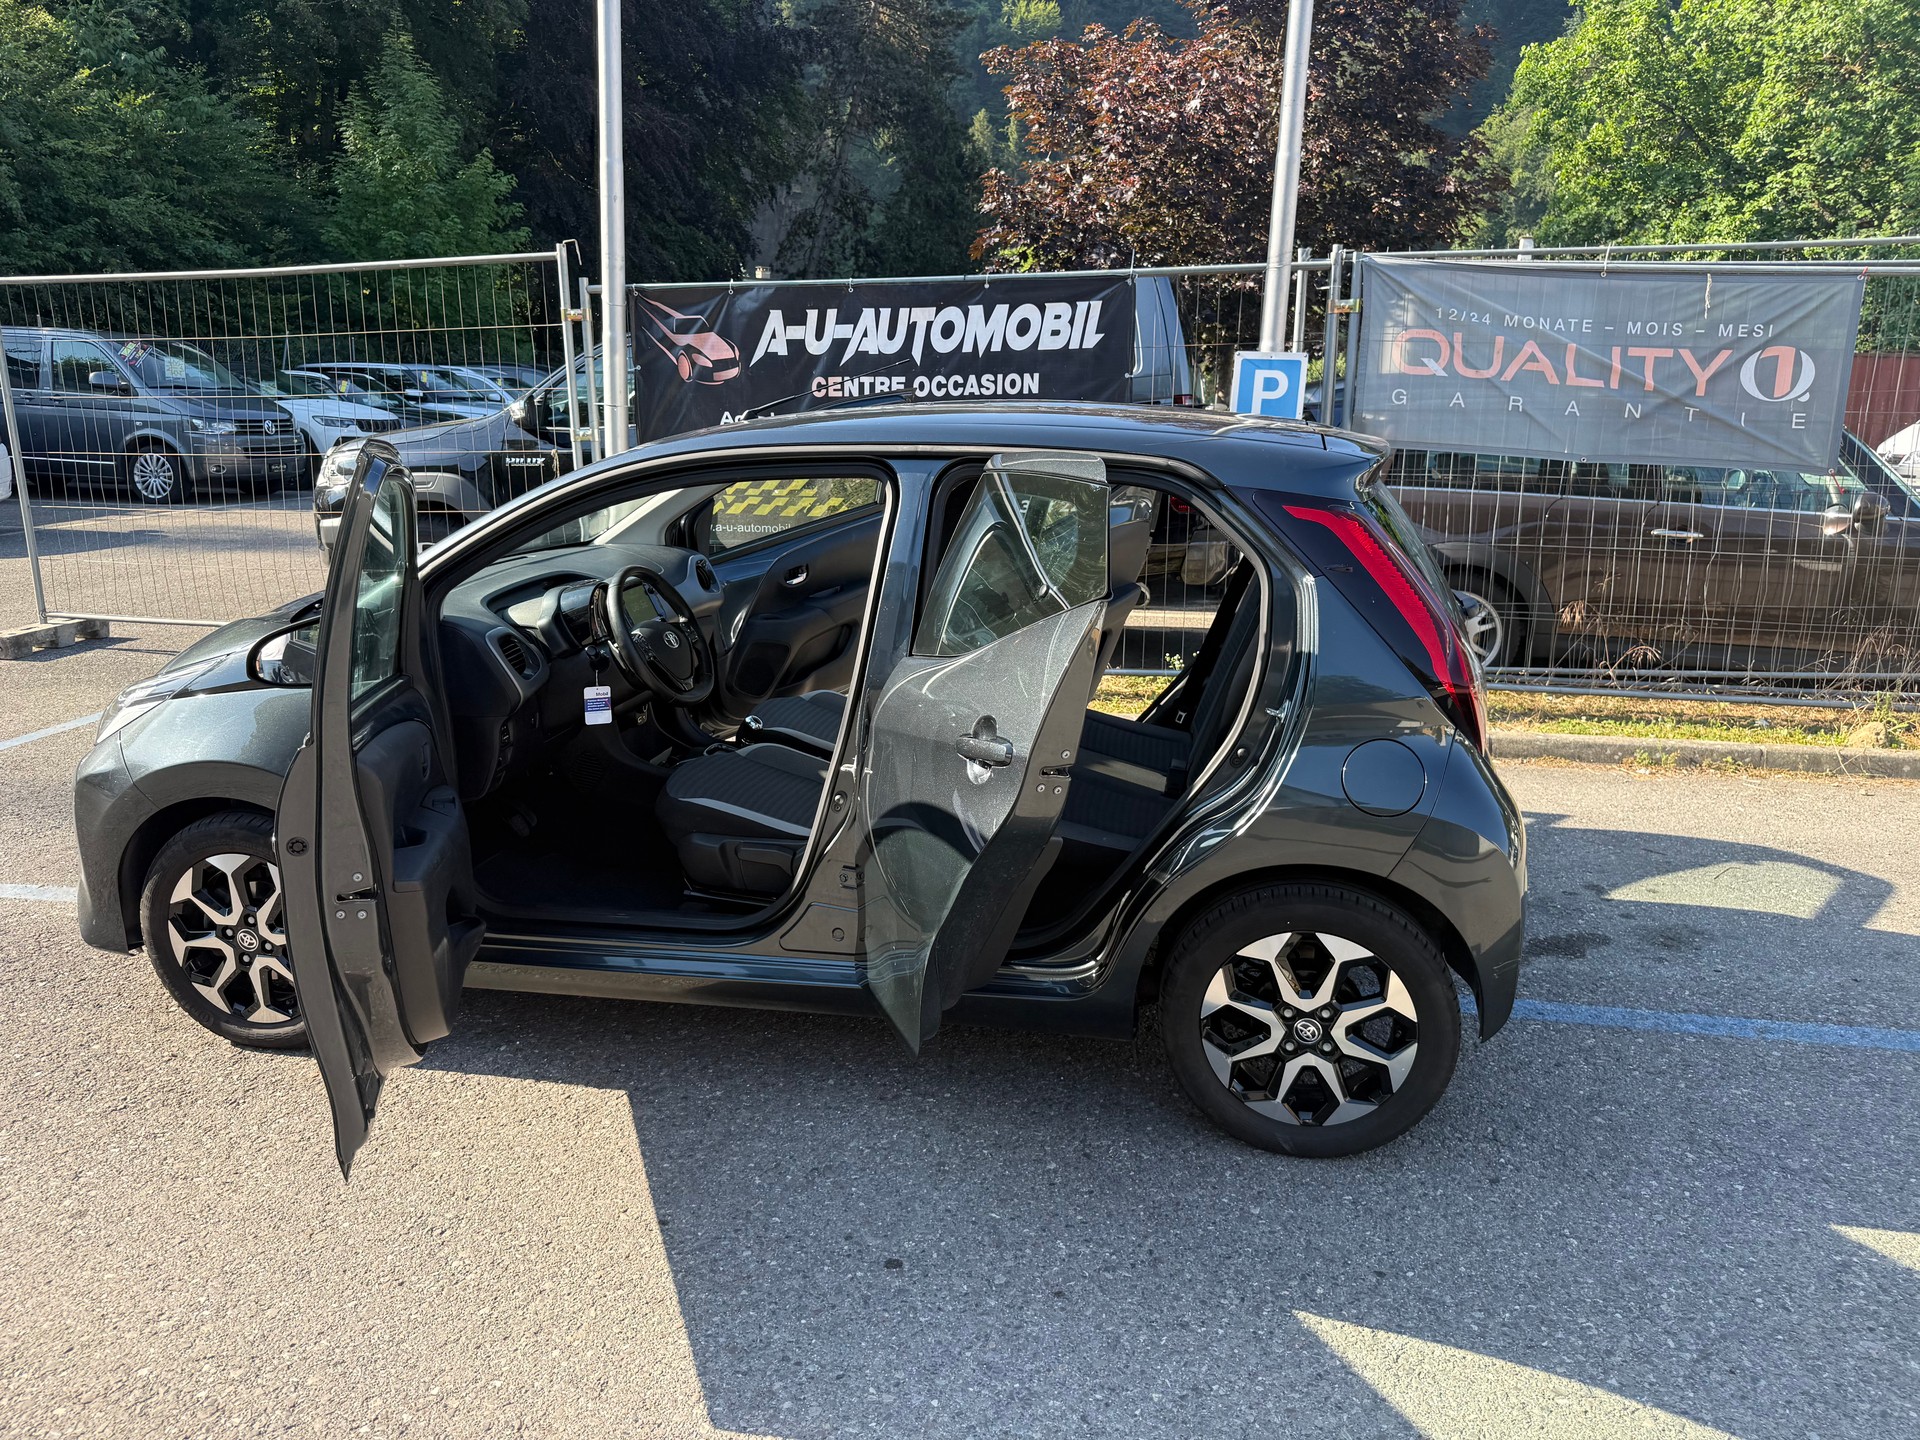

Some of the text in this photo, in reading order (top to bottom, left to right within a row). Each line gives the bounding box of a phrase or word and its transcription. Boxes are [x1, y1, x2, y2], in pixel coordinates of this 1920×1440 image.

[748, 300, 1105, 367] A-U-AUTOMOBIL
[1435, 307, 1491, 325] 12/24
[1503, 314, 1593, 333] MONATE
[1626, 321, 1683, 336] MOIS
[1718, 323, 1774, 338] MESI
[1393, 328, 1734, 397] QUALITY
[913, 373, 1040, 397] OCCASION
[1251, 369, 1289, 415] P
[1391, 388, 1807, 429] GARANTIE
